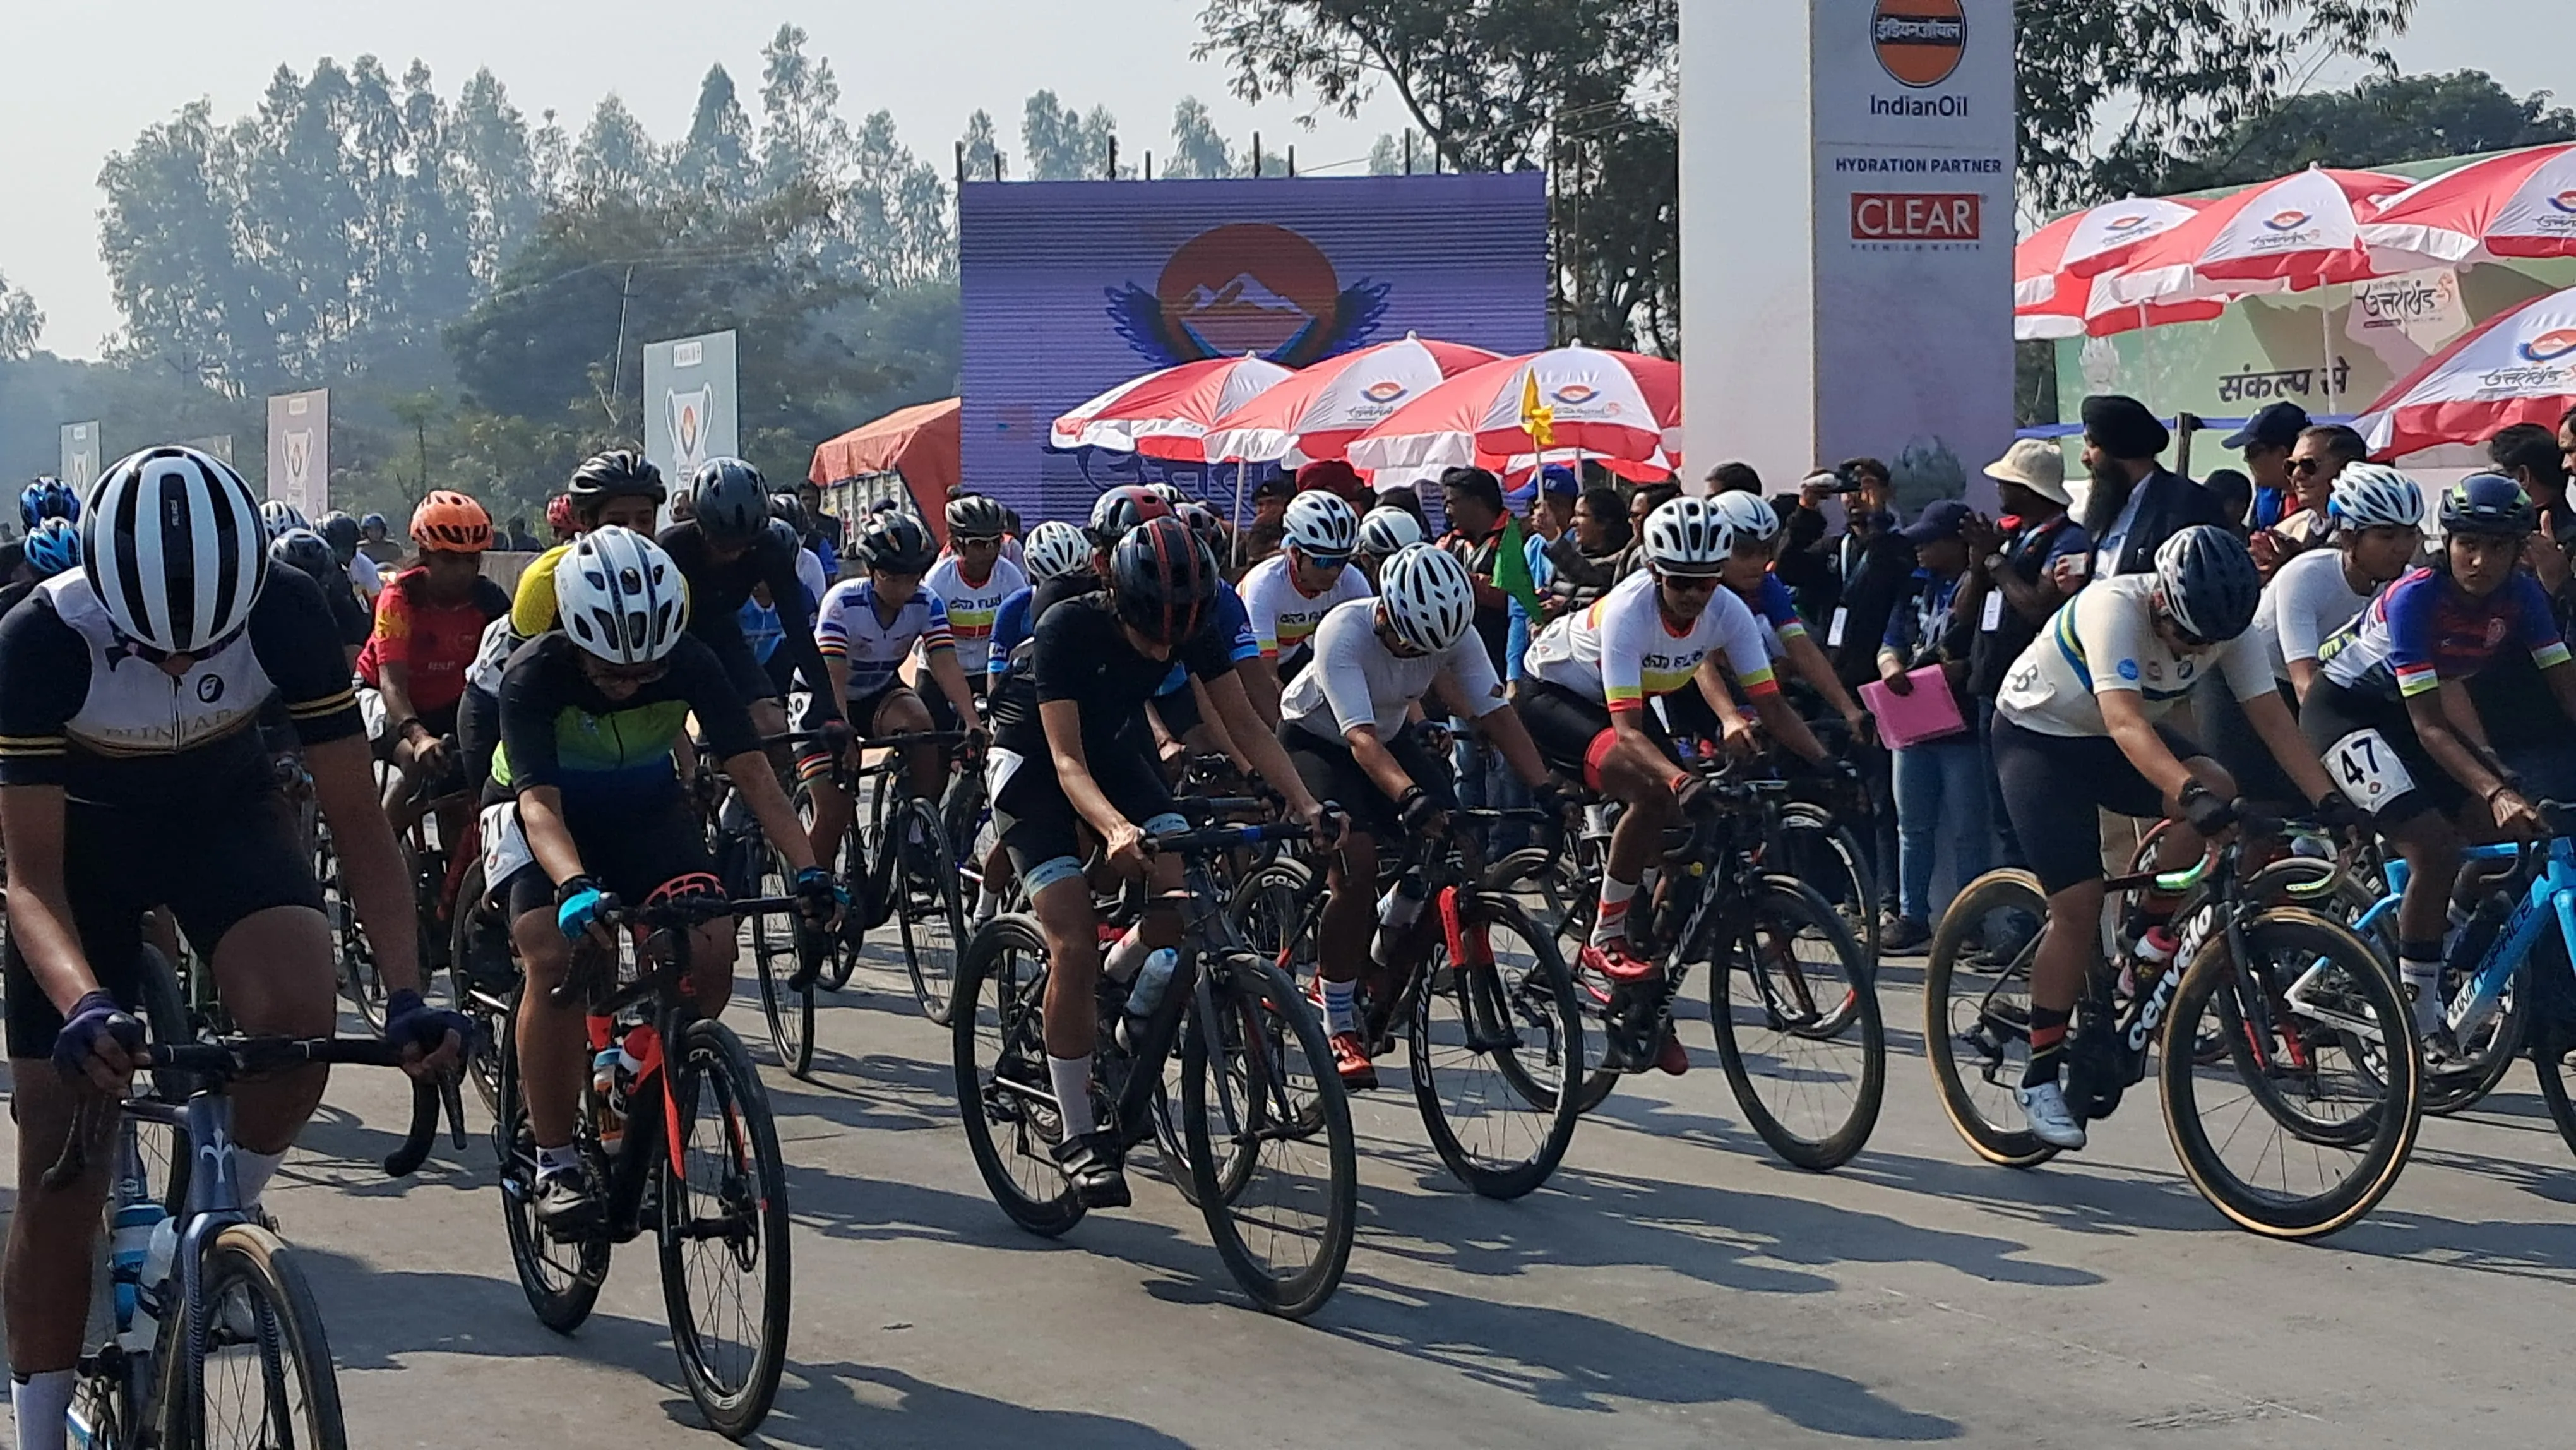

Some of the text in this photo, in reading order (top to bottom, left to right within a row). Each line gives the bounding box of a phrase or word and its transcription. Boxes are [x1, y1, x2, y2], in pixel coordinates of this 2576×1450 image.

[1870, 95, 1968, 117] IndianOil
[1835, 159, 2001, 174] HYDRATION PARTNER
[1857, 198, 1973, 236] CLEAR
[2219, 363, 2313, 402] संकल्प
[2341, 736, 2380, 785] 47
